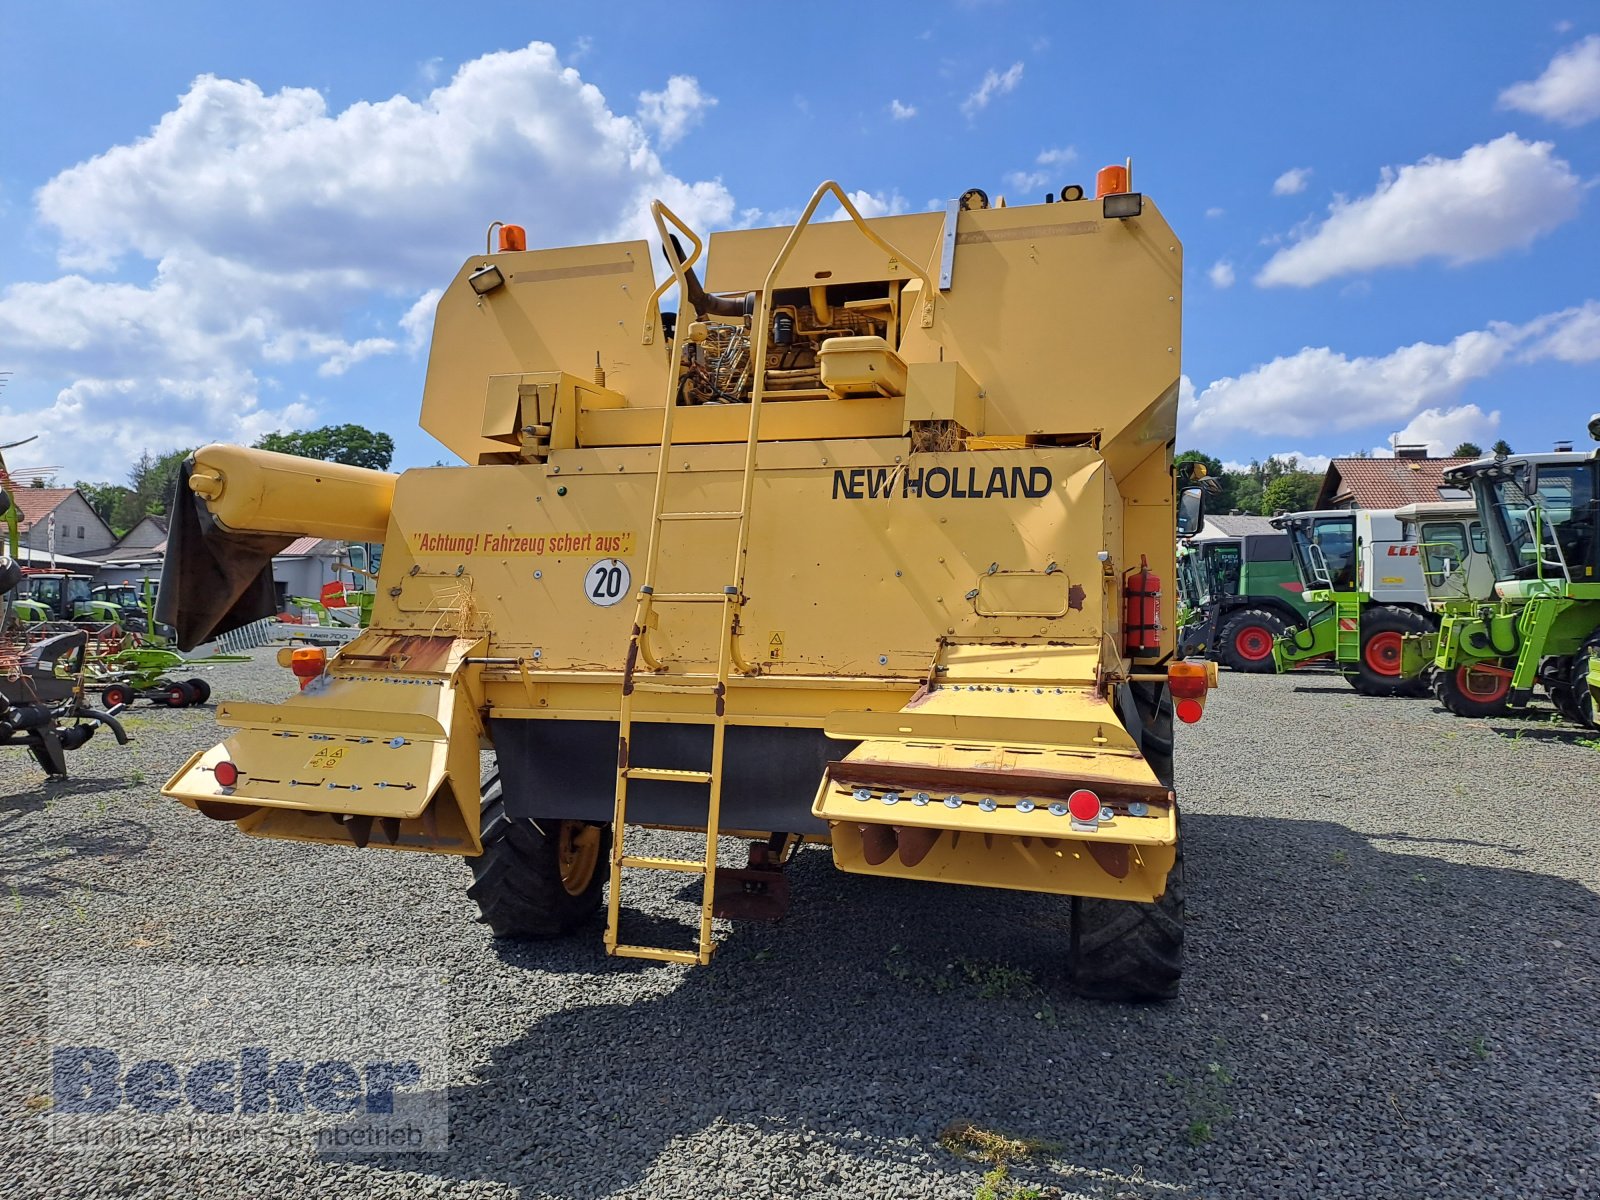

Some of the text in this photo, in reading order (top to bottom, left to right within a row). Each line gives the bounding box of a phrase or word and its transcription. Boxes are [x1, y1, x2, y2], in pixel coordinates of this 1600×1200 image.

[832, 466, 1052, 499] NEW HOLLAND
[483, 533, 545, 555] Fahrzeug
[549, 533, 592, 552] schert
[592, 567, 622, 598] 20
